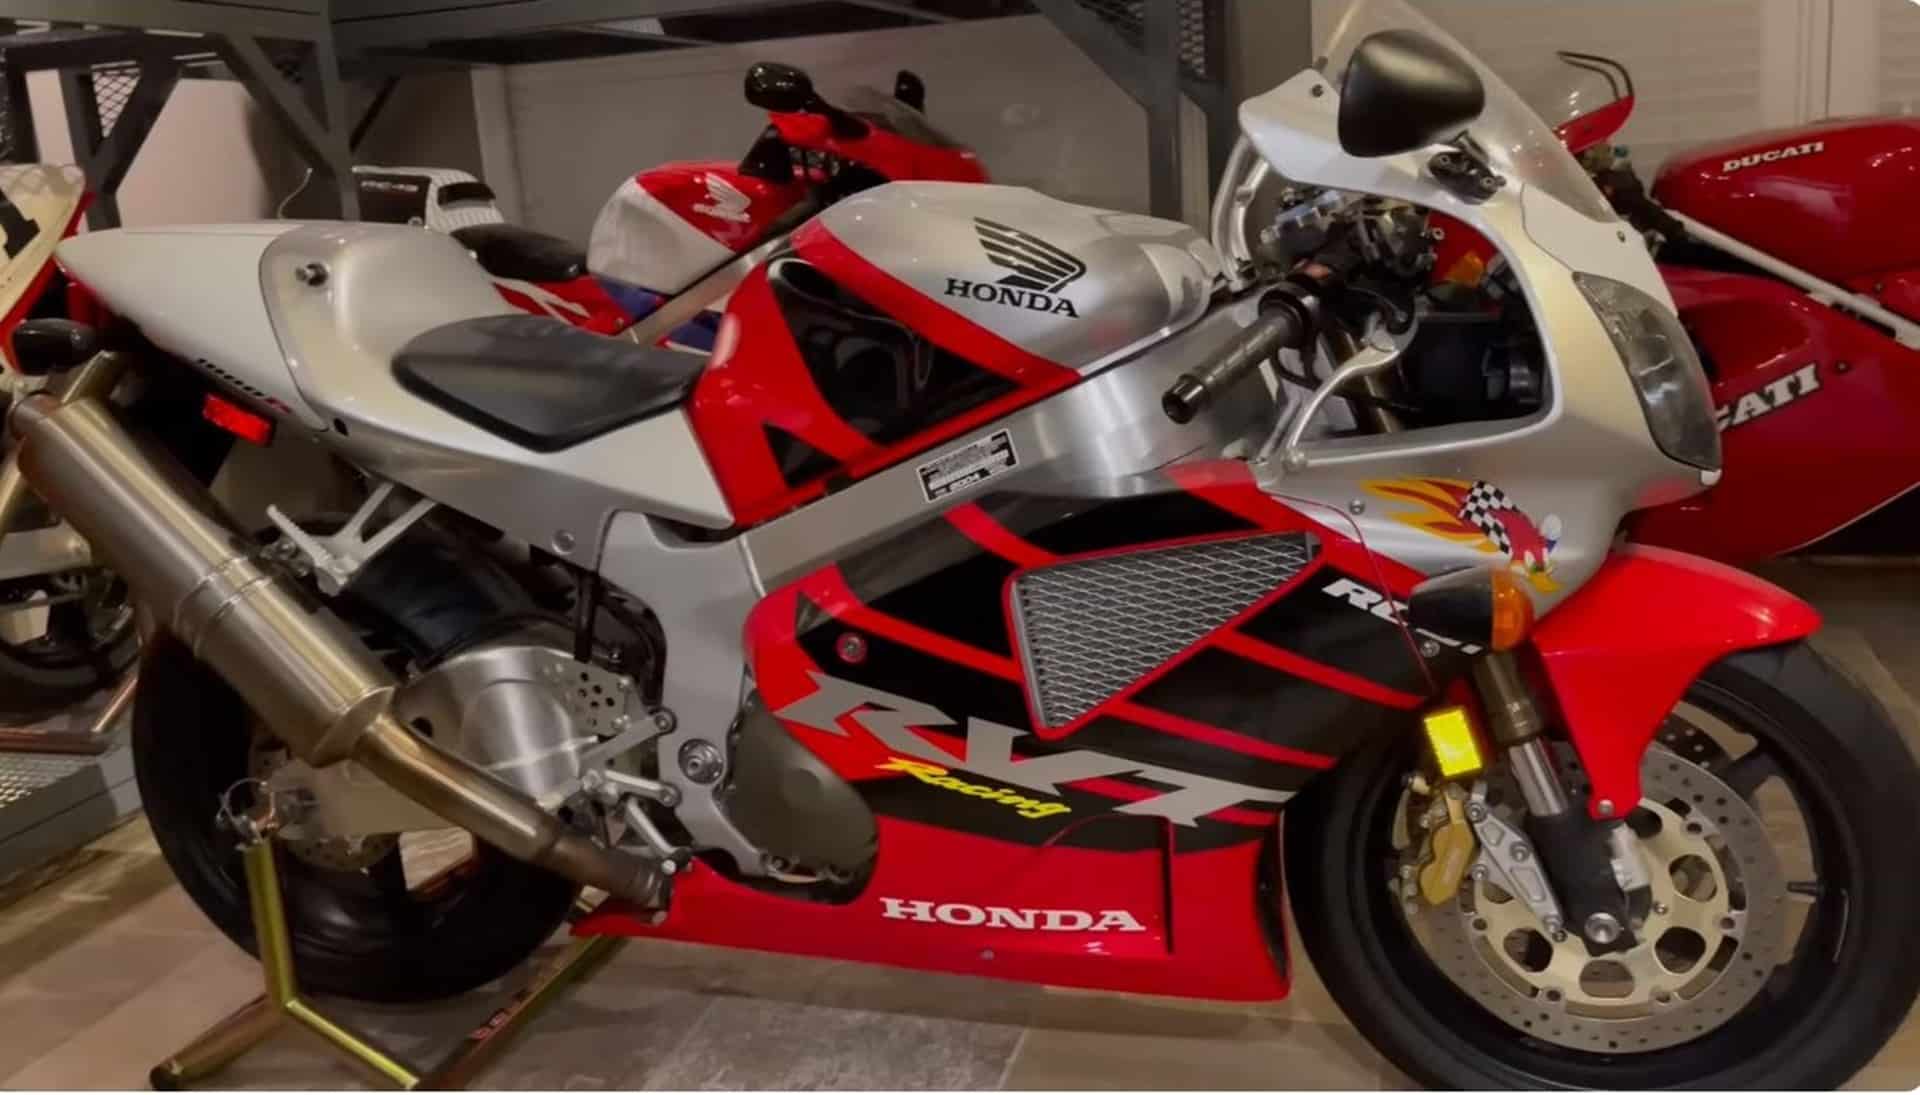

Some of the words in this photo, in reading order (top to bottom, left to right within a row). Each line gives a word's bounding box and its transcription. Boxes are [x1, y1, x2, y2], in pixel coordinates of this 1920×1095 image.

[1722, 141, 1824, 173] DUCATI
[943, 278, 1080, 319] HONDA
[1322, 578, 1483, 654] RC
[774, 671, 1296, 827] RVT
[875, 757, 1071, 817] Racing
[880, 898, 1146, 931] HONDA
